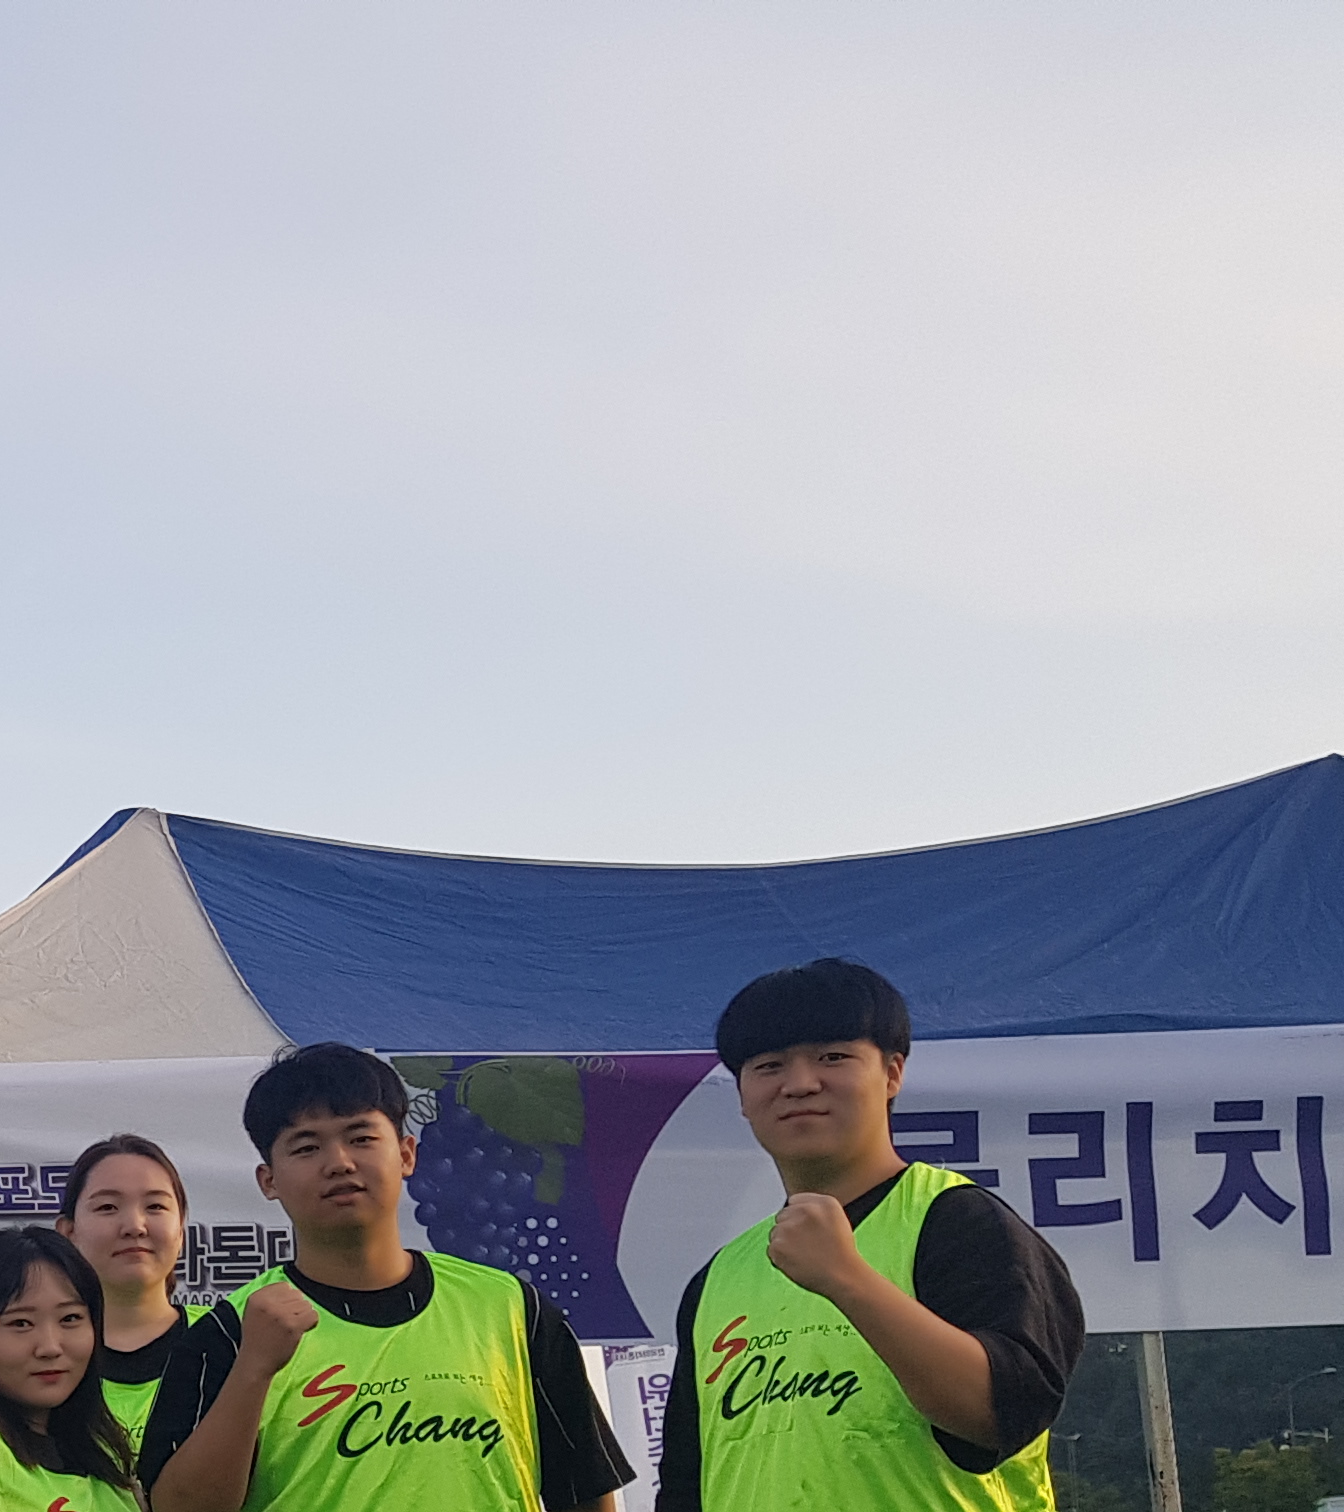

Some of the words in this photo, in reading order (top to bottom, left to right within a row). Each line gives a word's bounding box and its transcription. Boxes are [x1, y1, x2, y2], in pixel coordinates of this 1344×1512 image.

[173, 1291, 230, 1307] MARA
[297, 1364, 410, 1428] Sports
[336, 1400, 505, 1459] Chang
